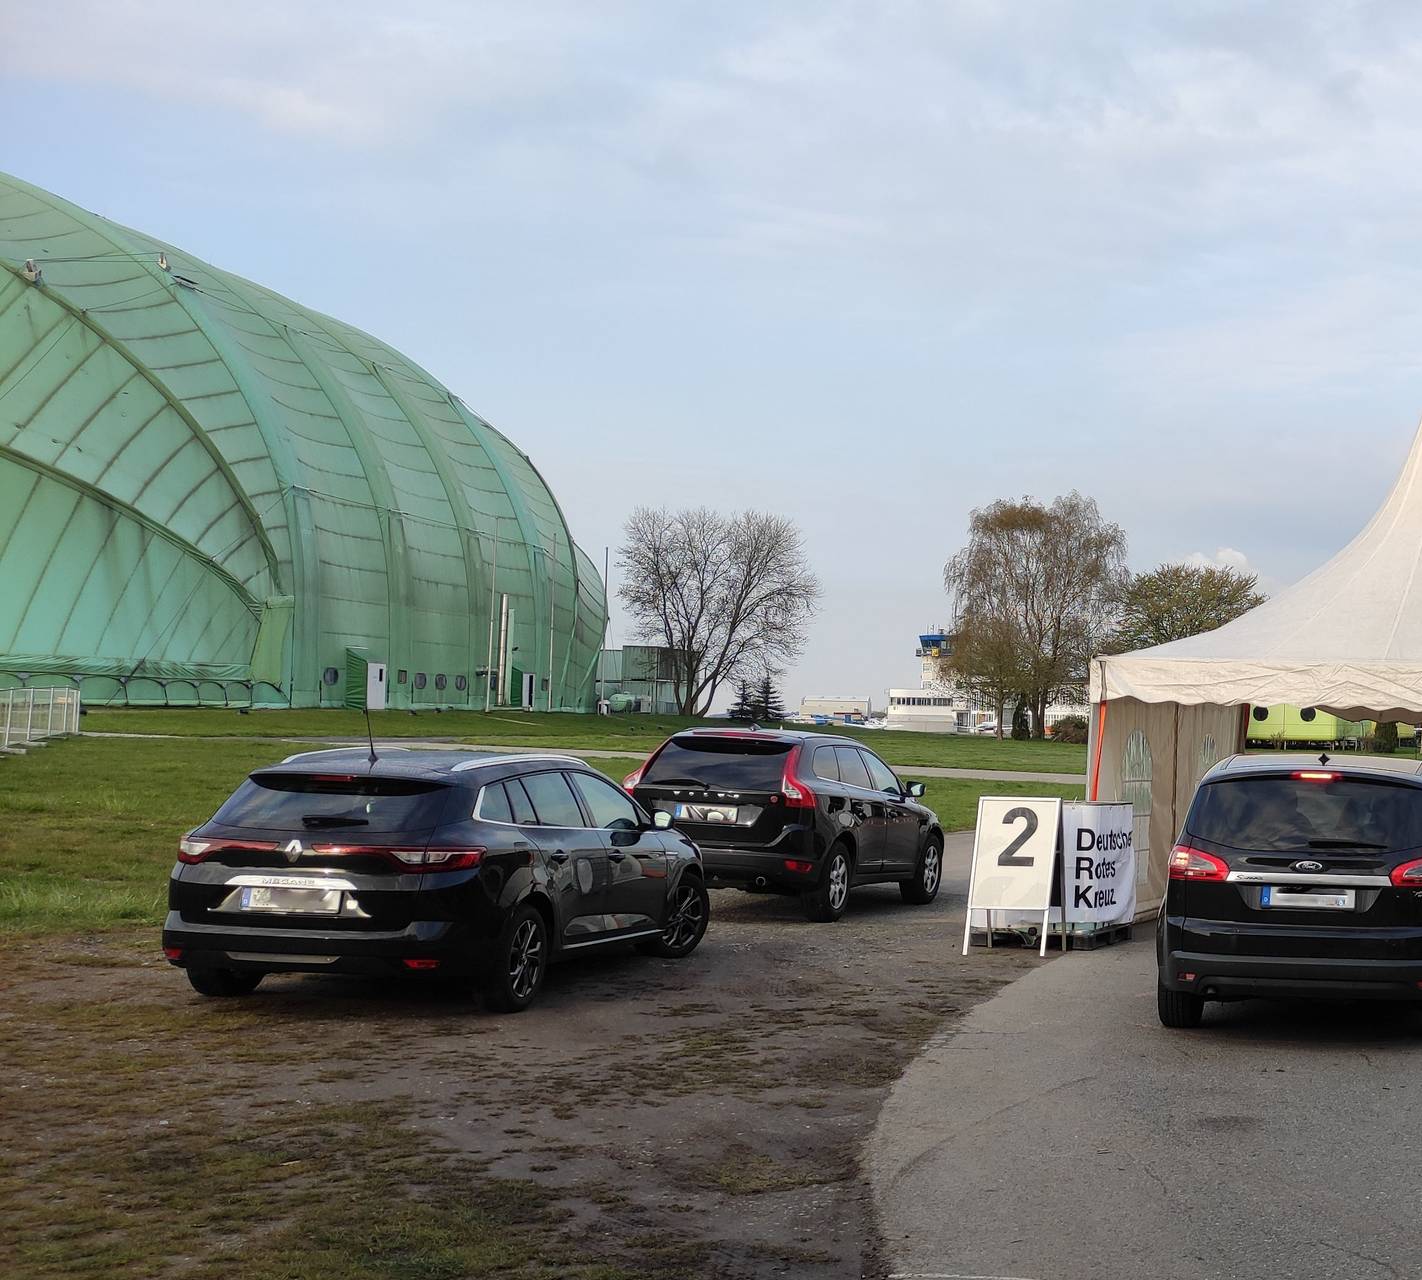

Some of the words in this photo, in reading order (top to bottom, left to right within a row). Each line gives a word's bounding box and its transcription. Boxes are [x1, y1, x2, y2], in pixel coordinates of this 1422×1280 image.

[998, 807, 1039, 867] 2
[1075, 857, 1117, 880] Rotes
[1074, 885, 1117, 909] Kreuz
